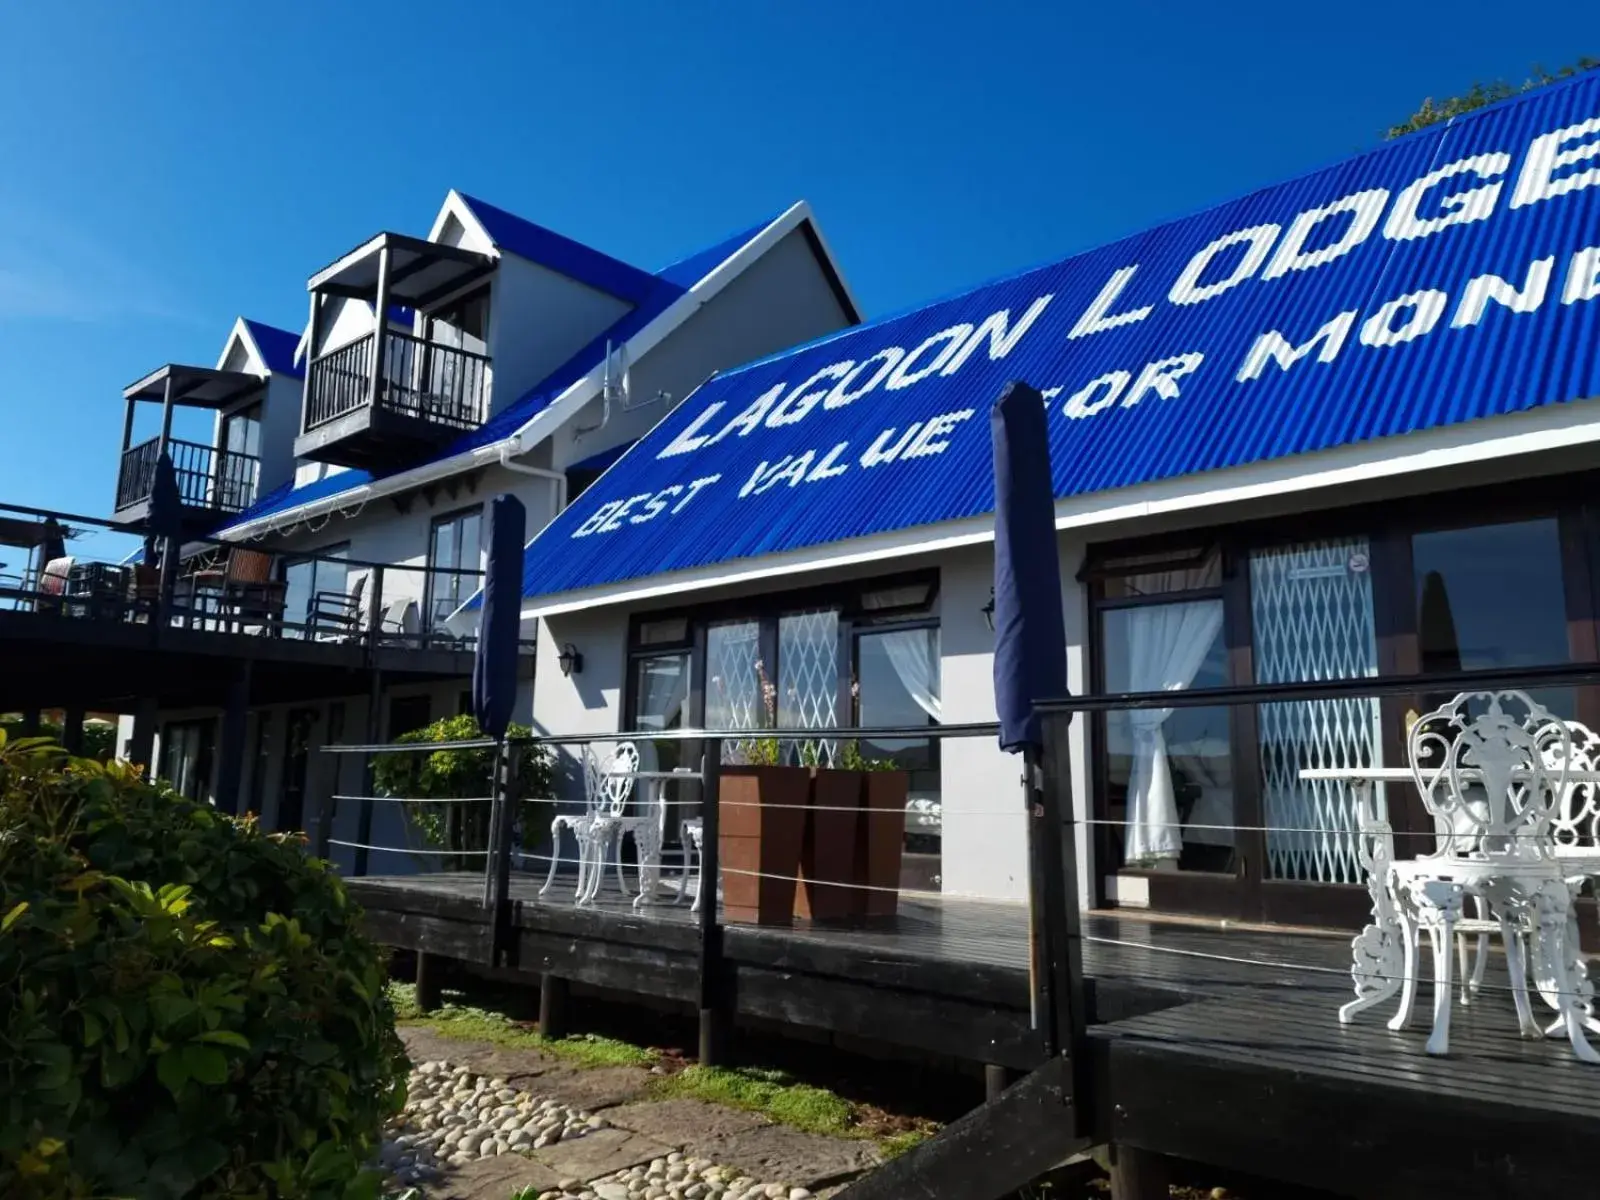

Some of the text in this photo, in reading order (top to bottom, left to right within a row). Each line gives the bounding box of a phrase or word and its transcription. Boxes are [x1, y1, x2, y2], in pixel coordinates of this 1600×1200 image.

[656, 117, 1600, 460] LAGOON LODGE
[571, 473, 722, 539] BEST
[738, 408, 975, 499] VALUE
